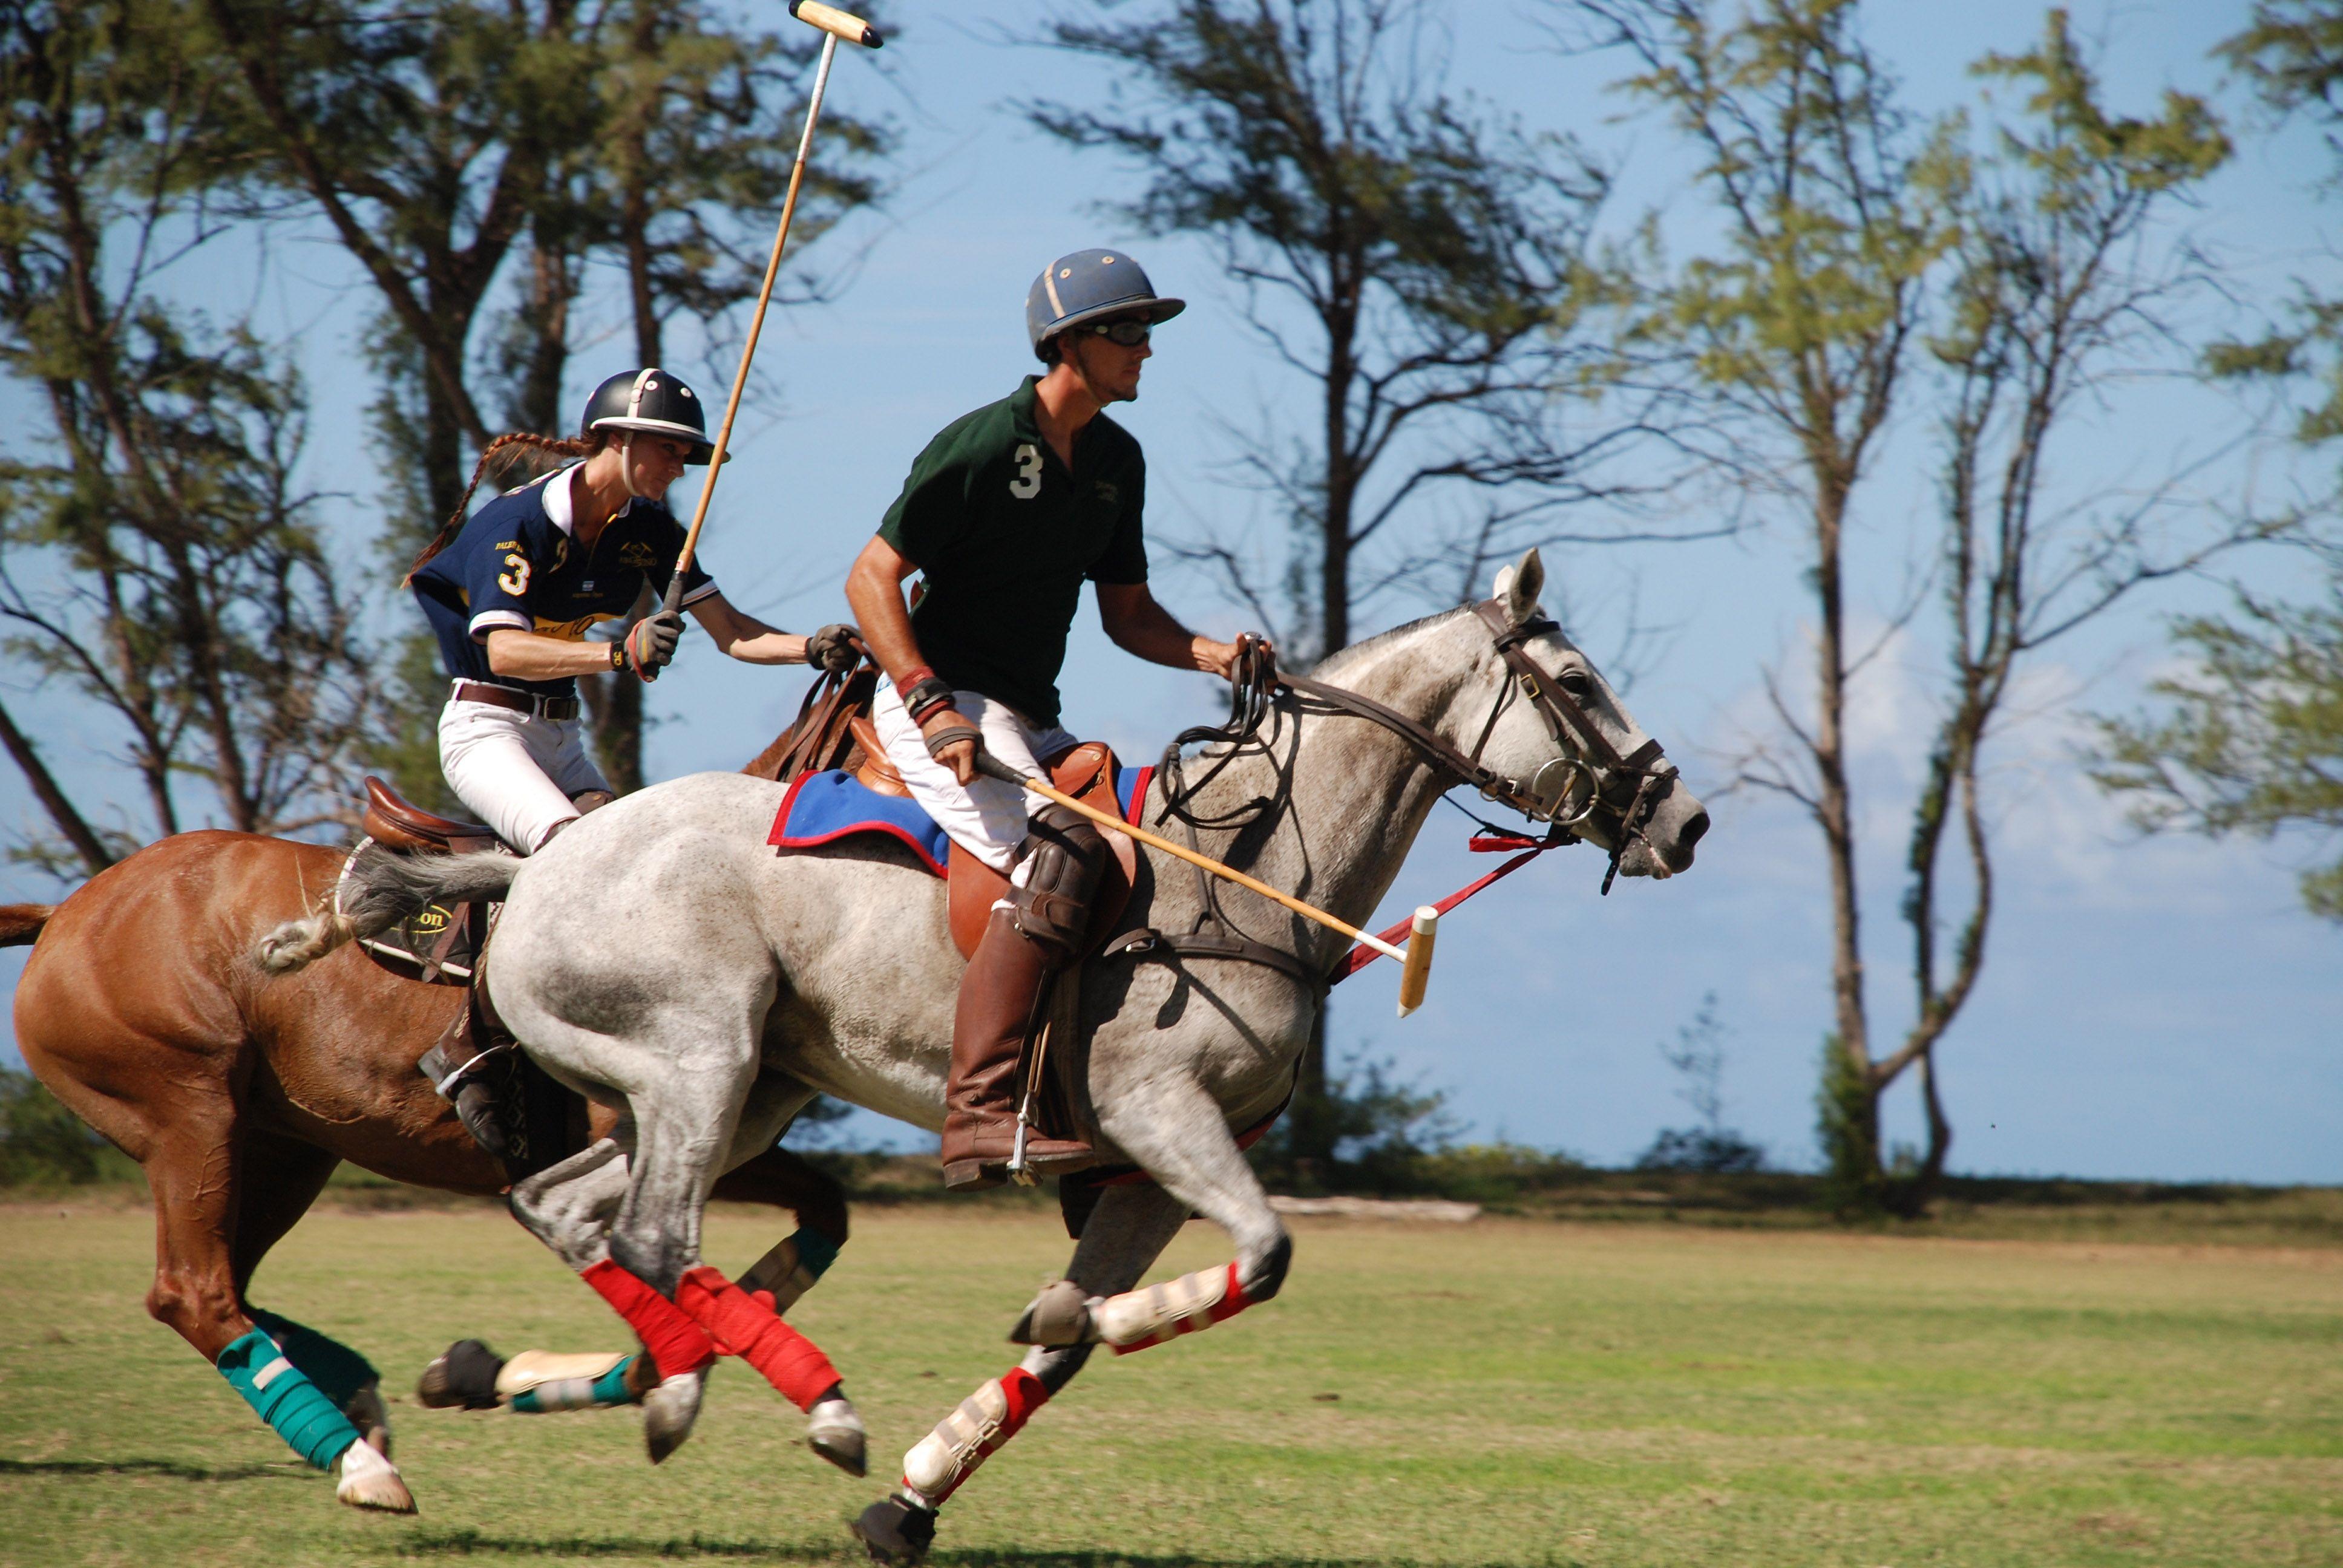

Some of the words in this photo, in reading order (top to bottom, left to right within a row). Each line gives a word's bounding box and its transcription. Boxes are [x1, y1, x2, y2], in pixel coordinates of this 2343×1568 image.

[1009, 444, 1044, 499] 3
[495, 540, 526, 553] PALER
[498, 553, 531, 596] 3
